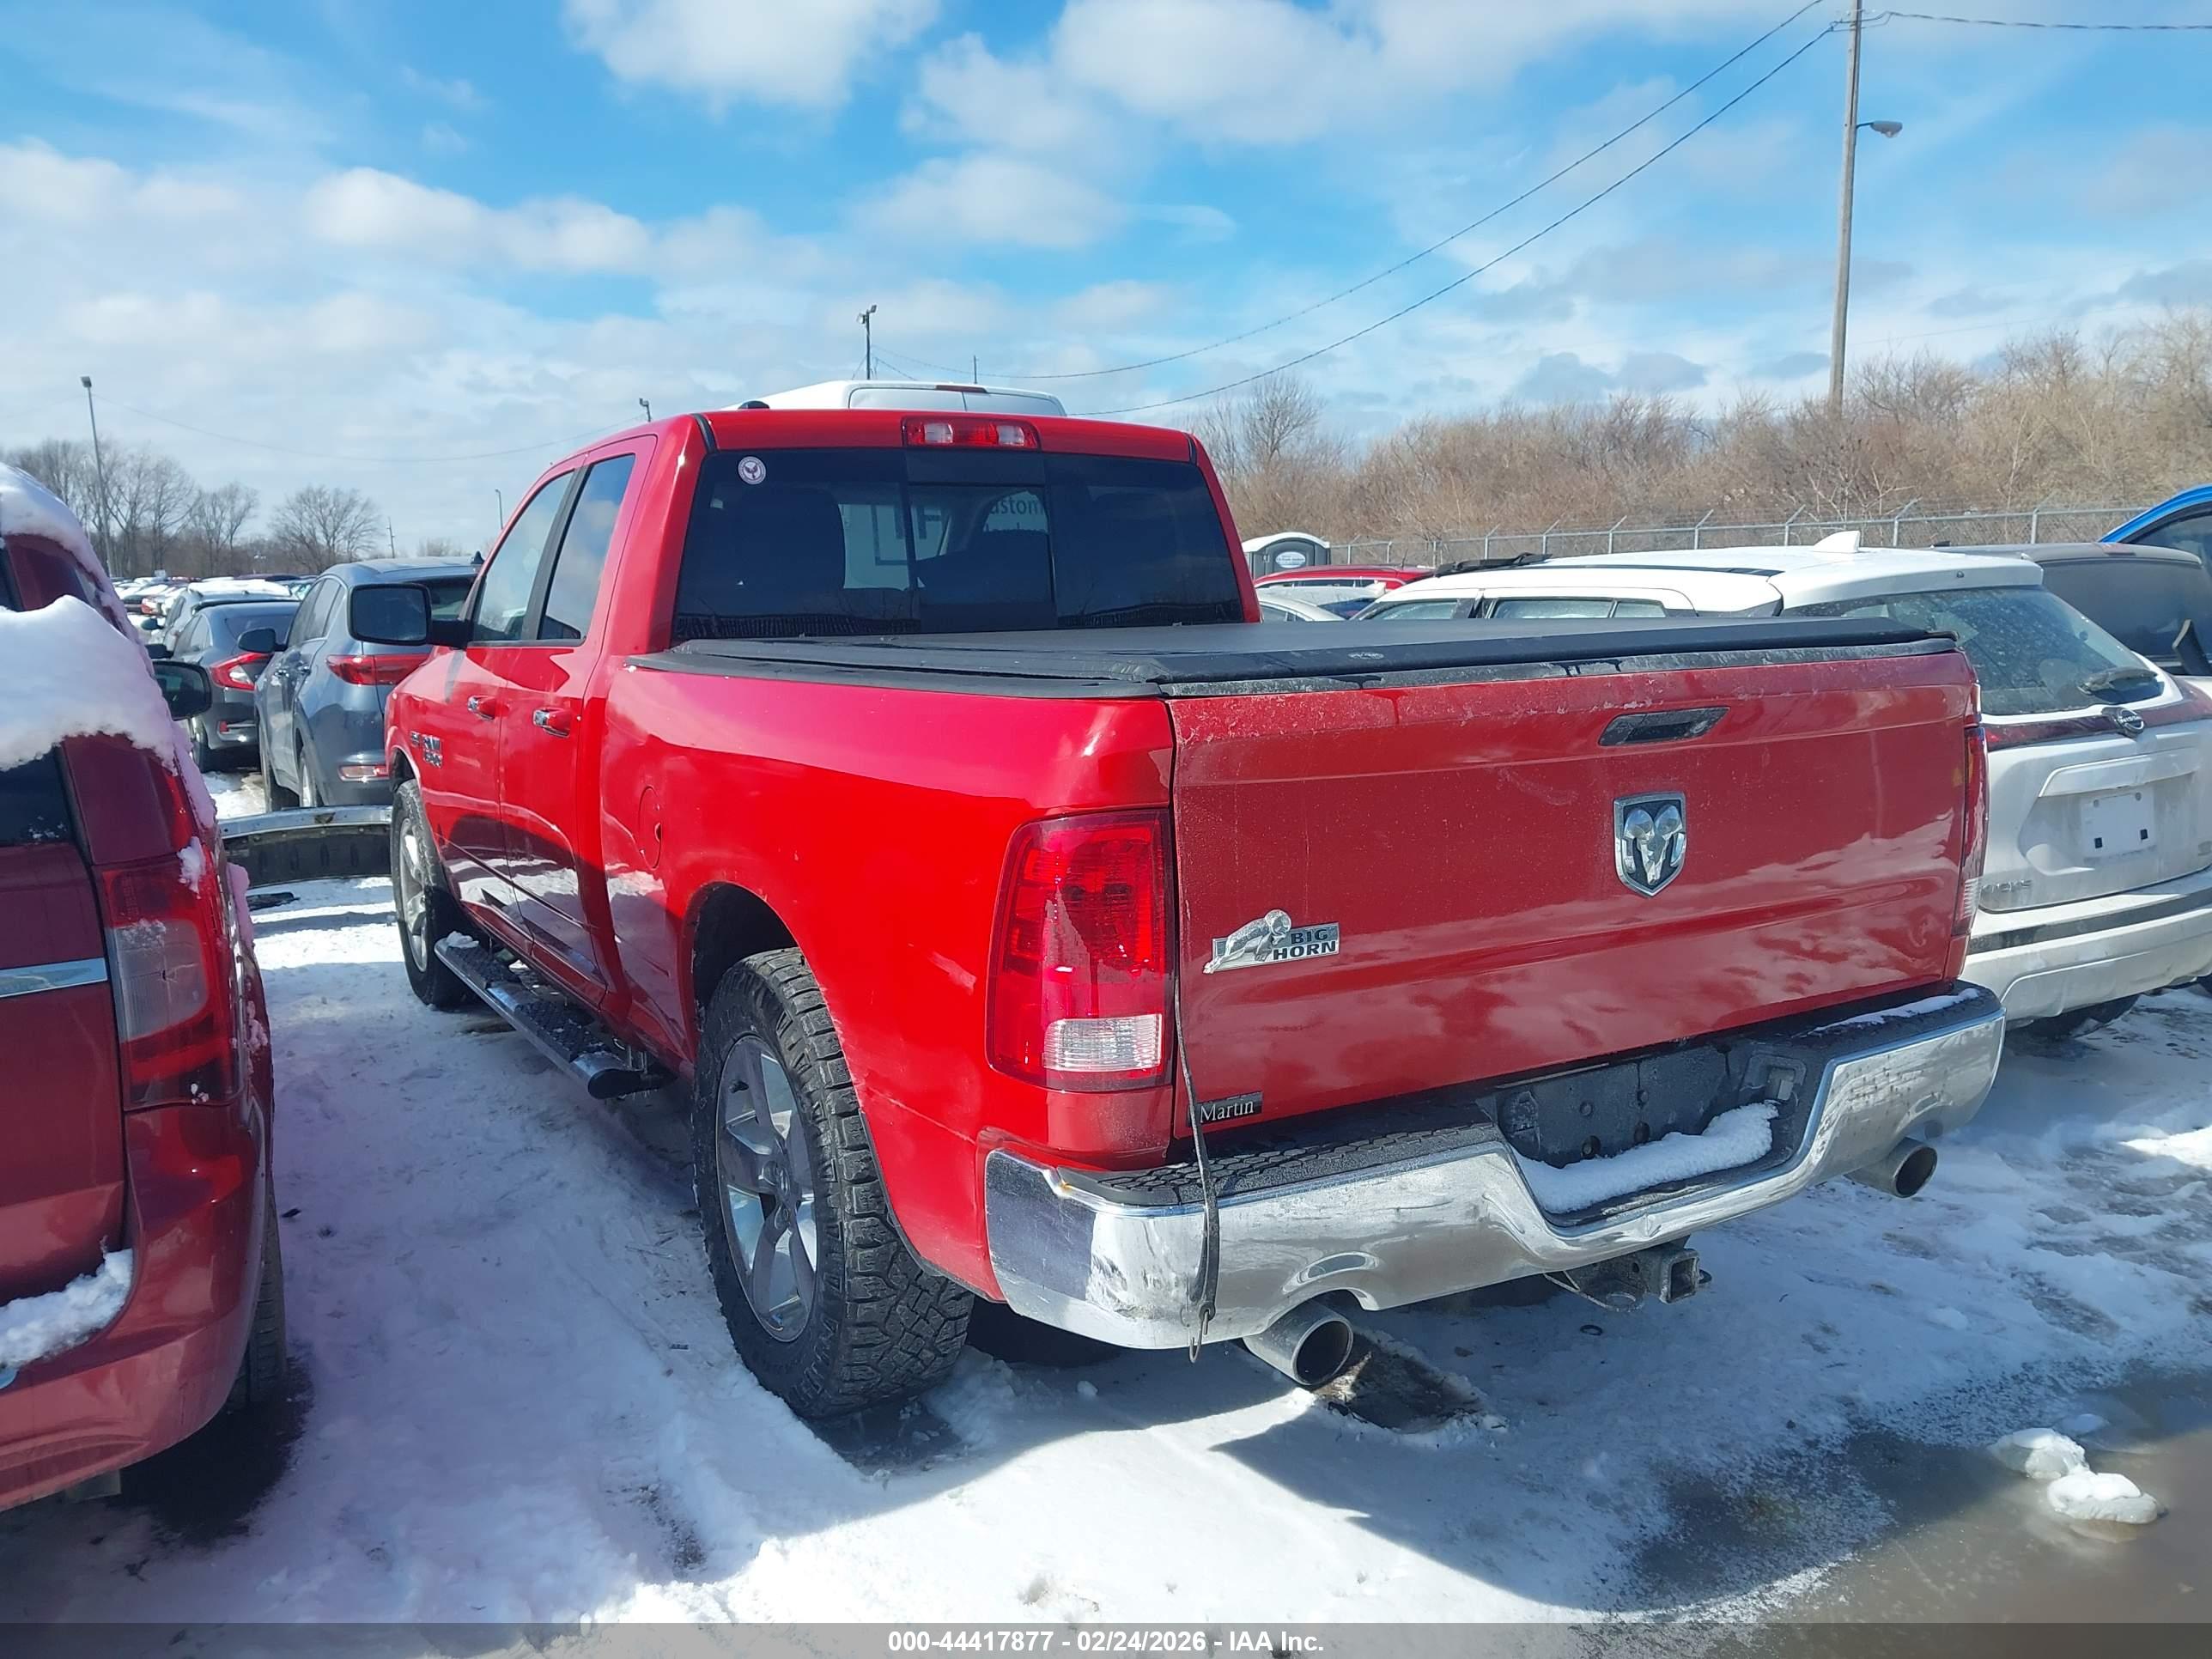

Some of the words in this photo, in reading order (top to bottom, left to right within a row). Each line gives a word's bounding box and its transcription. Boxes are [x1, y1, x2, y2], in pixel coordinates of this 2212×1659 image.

[1291, 929, 1328, 945] BIG
[1273, 940, 1336, 961] HORN
[1200, 1099, 1255, 1123] Martin
